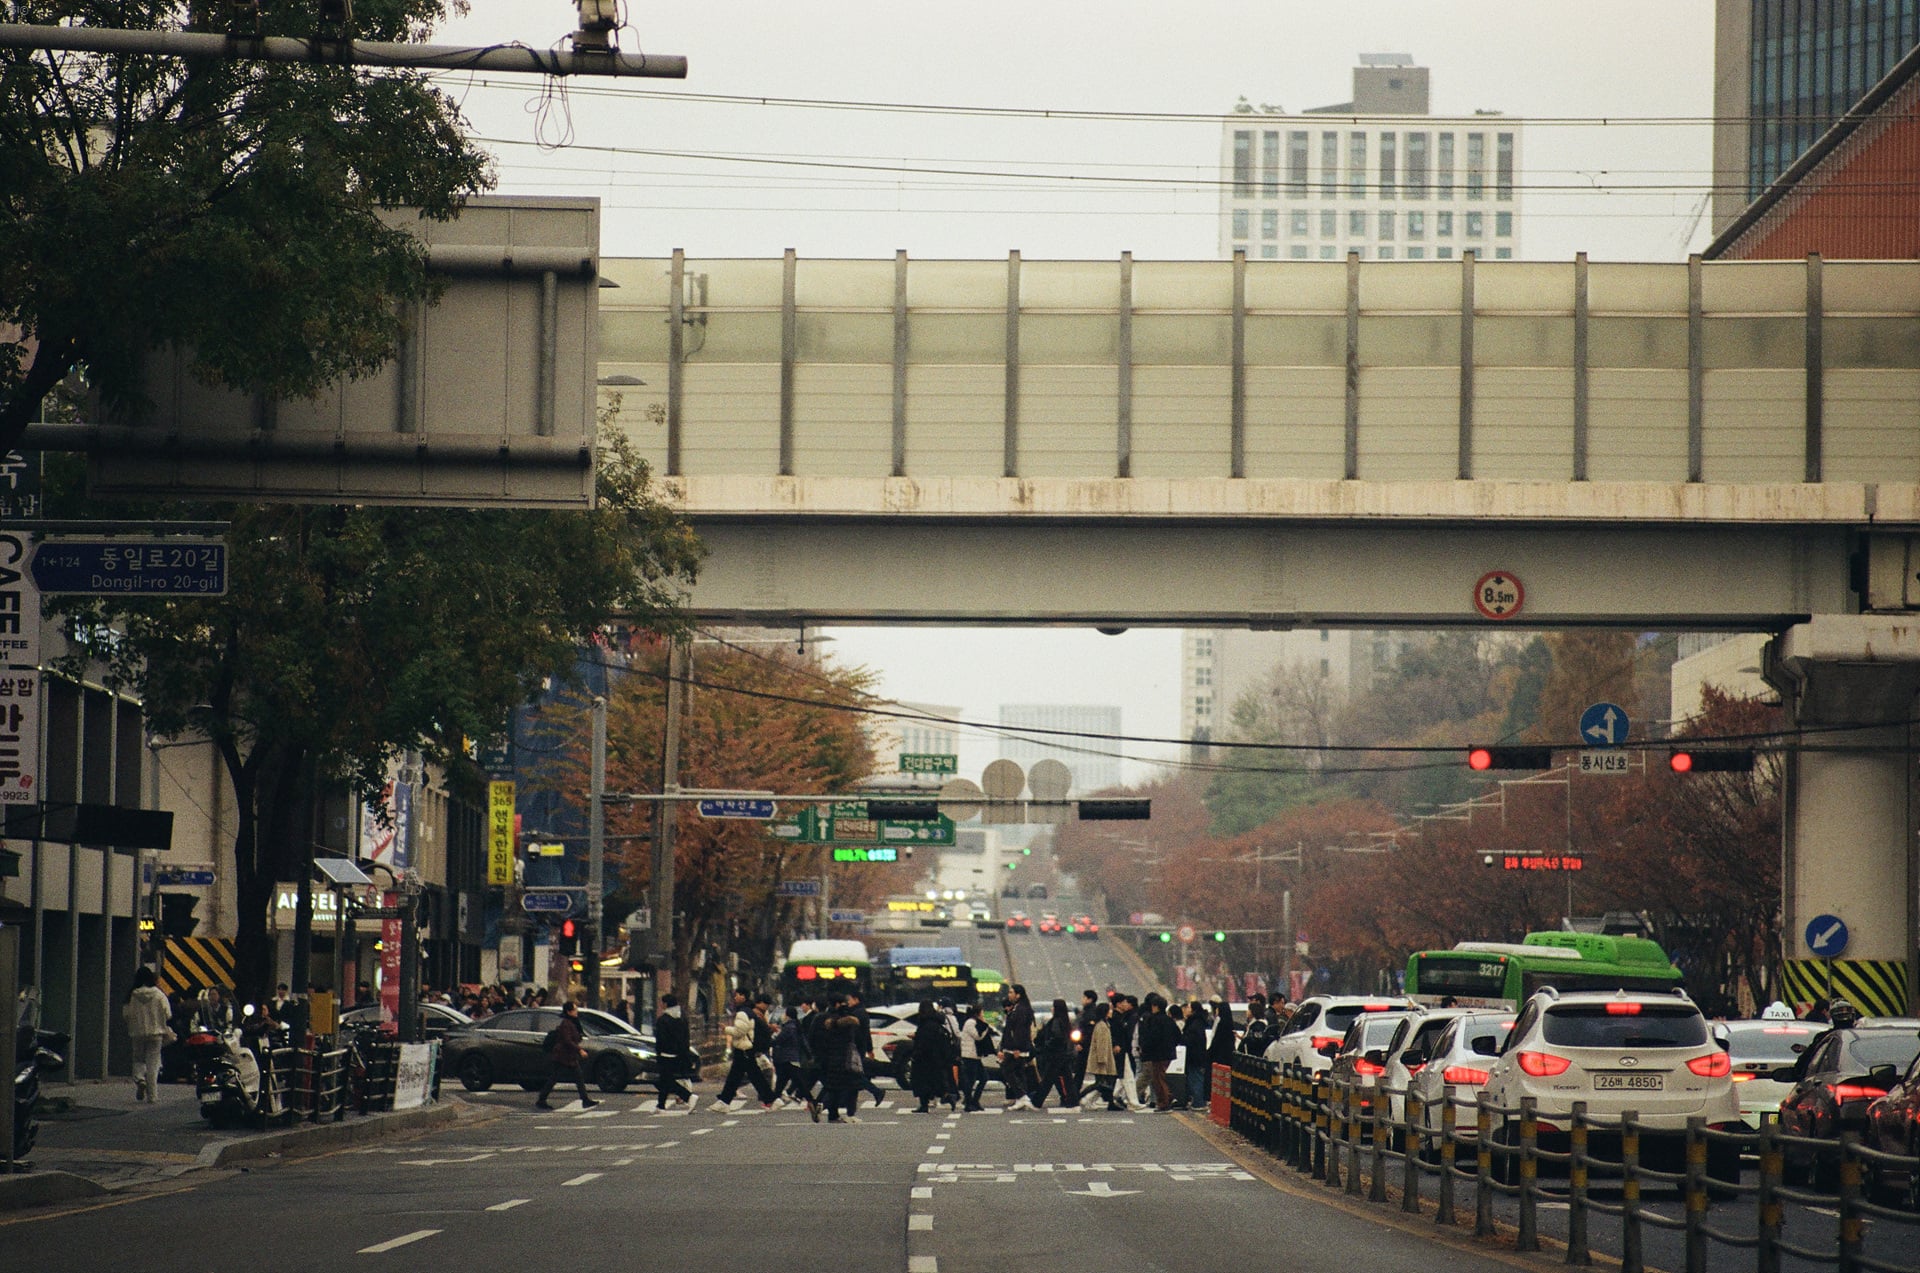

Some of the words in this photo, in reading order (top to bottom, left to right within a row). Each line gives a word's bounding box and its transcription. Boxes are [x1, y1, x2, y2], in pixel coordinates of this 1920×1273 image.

[99, 547, 219, 571] 동일로20길
[91, 574, 167, 592] Dongil-ro
[173, 575, 218, 592] 20-gil
[1484, 587, 1514, 603] 8.5m
[1581, 755, 1627, 770] 동시신호
[493, 797, 512, 807] 365
[1478, 963, 1505, 977] 3217
[1770, 1010, 1790, 1018] TAXI
[1627, 1076, 1657, 1088] 4850
